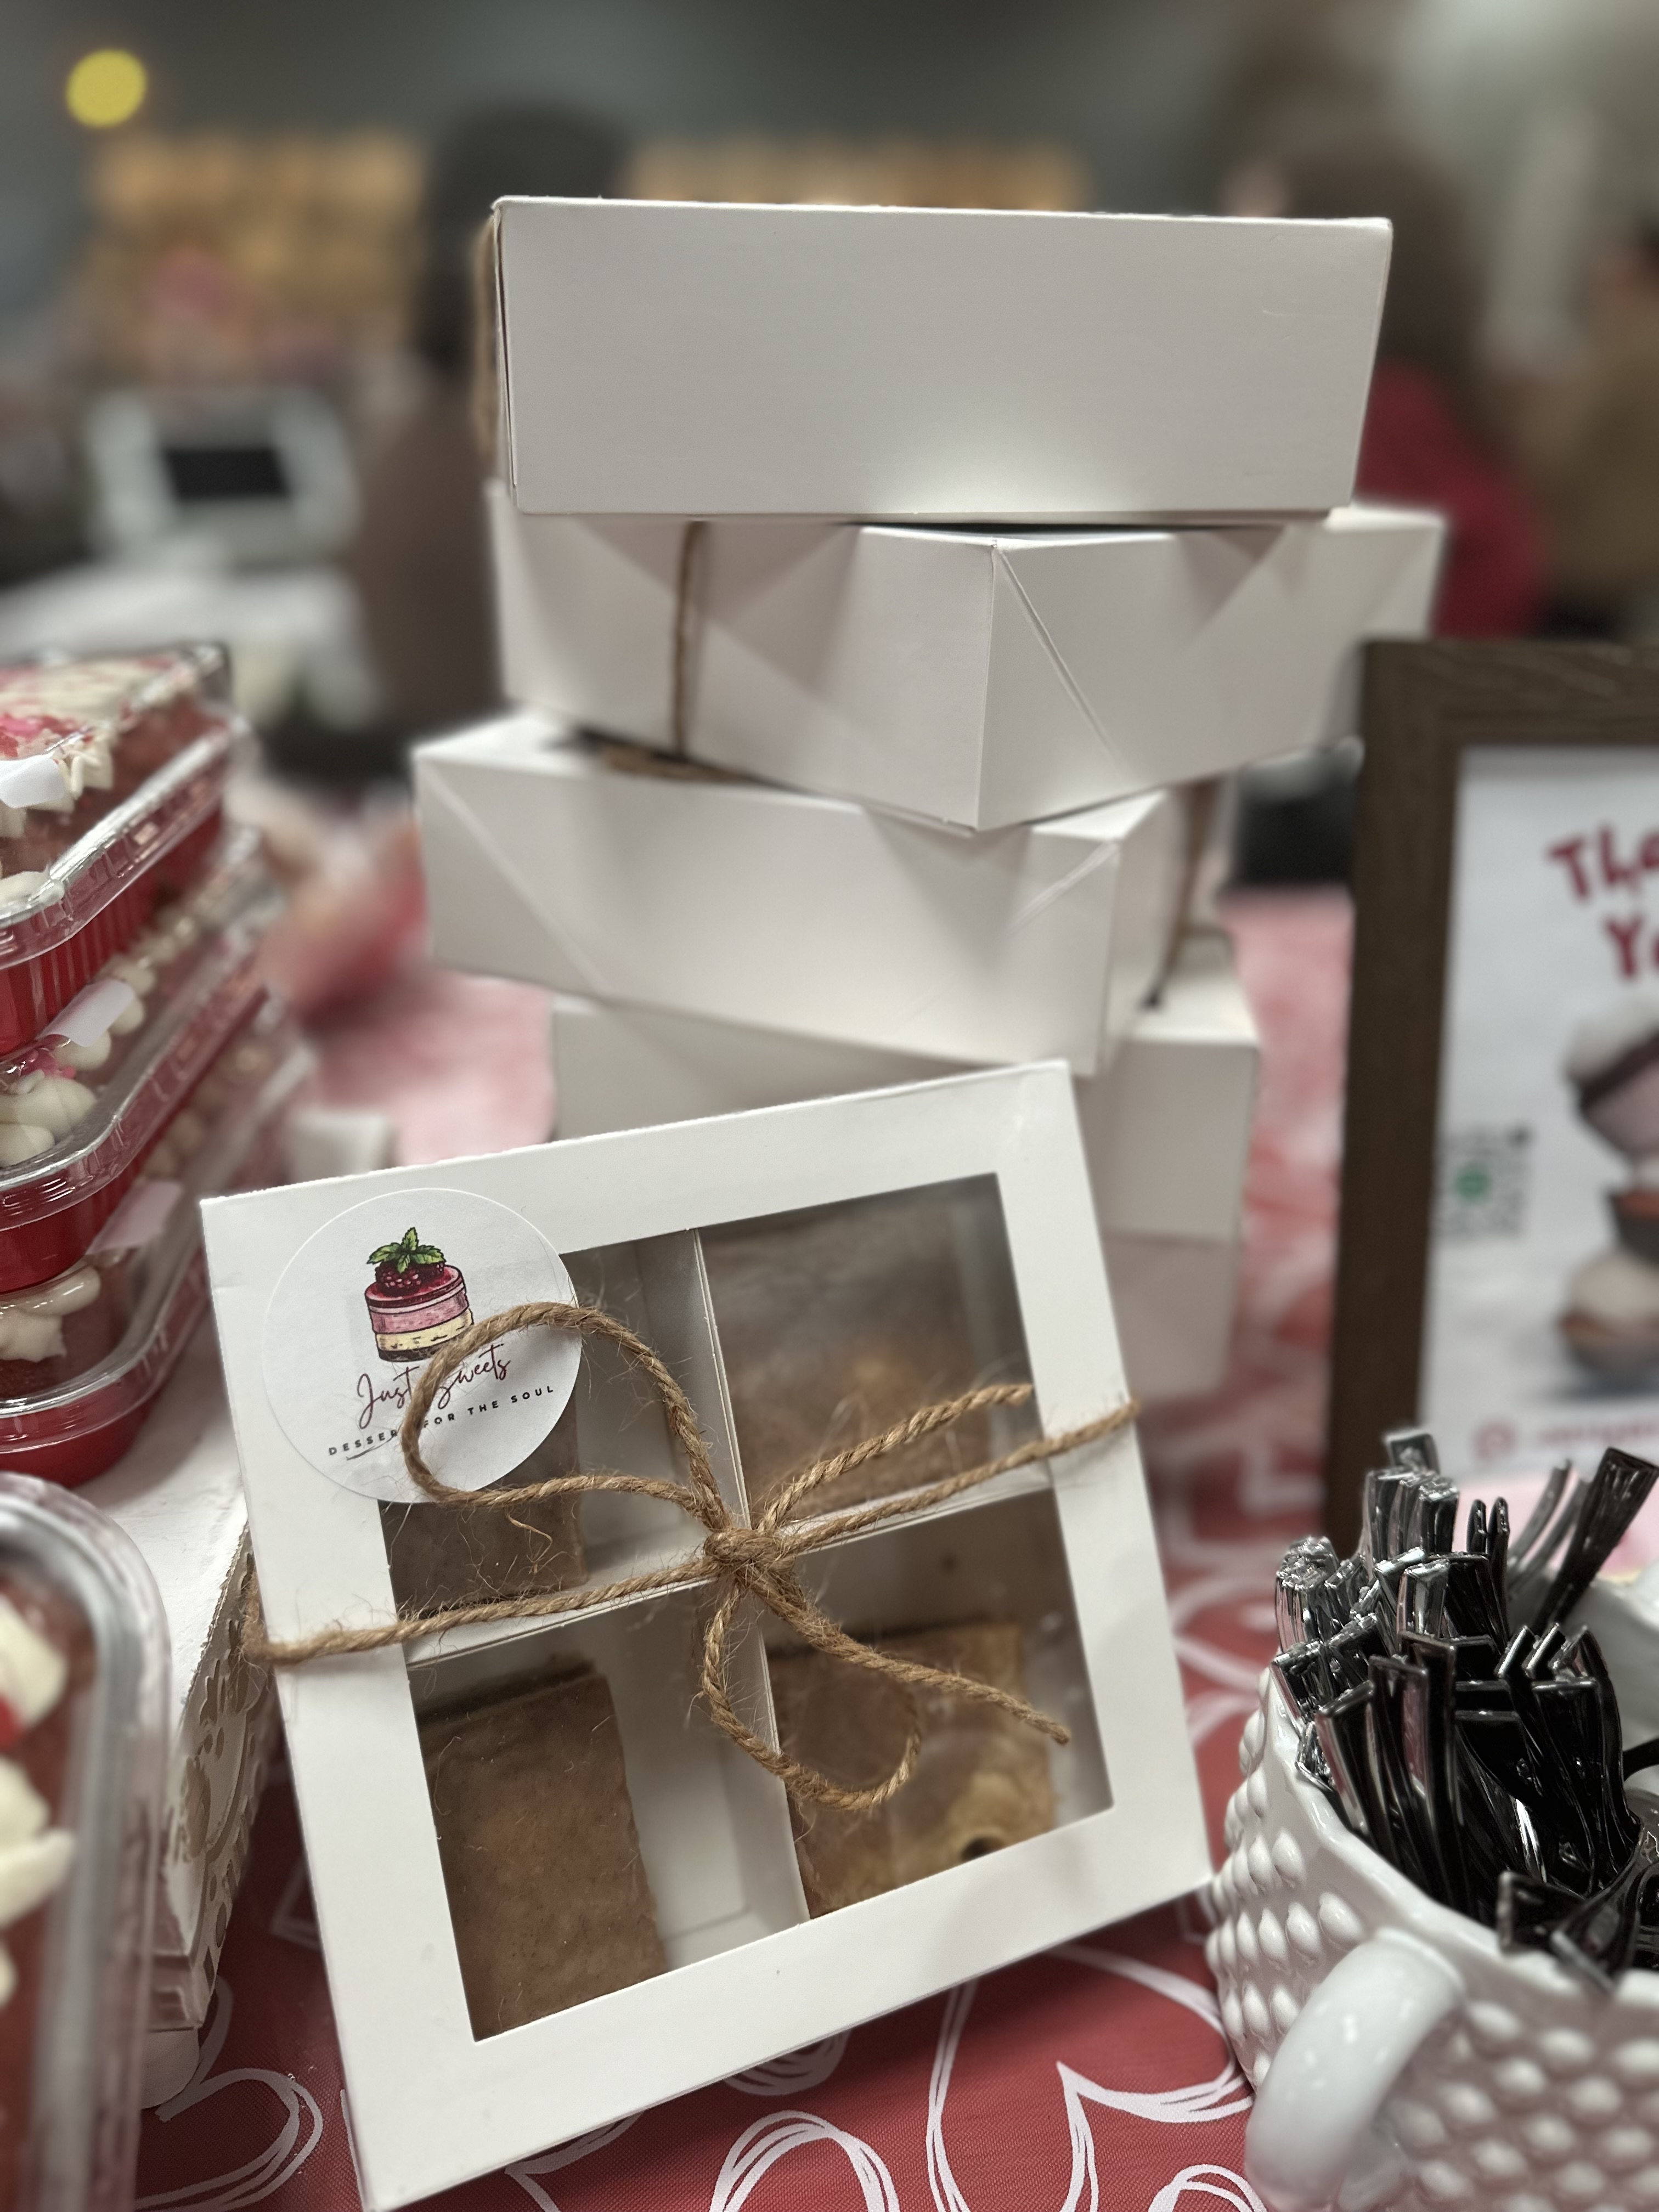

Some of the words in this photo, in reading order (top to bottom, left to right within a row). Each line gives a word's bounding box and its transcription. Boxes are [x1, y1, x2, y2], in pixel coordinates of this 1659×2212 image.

[1603, 913, 1659, 979] Y
[329, 1430, 398, 1455] DESSER
[424, 1413, 455, 1428] FOR
[467, 1400, 499, 1415] THE
[511, 1385, 554, 1403] SOUL
[357, 1366, 420, 1429] Just
